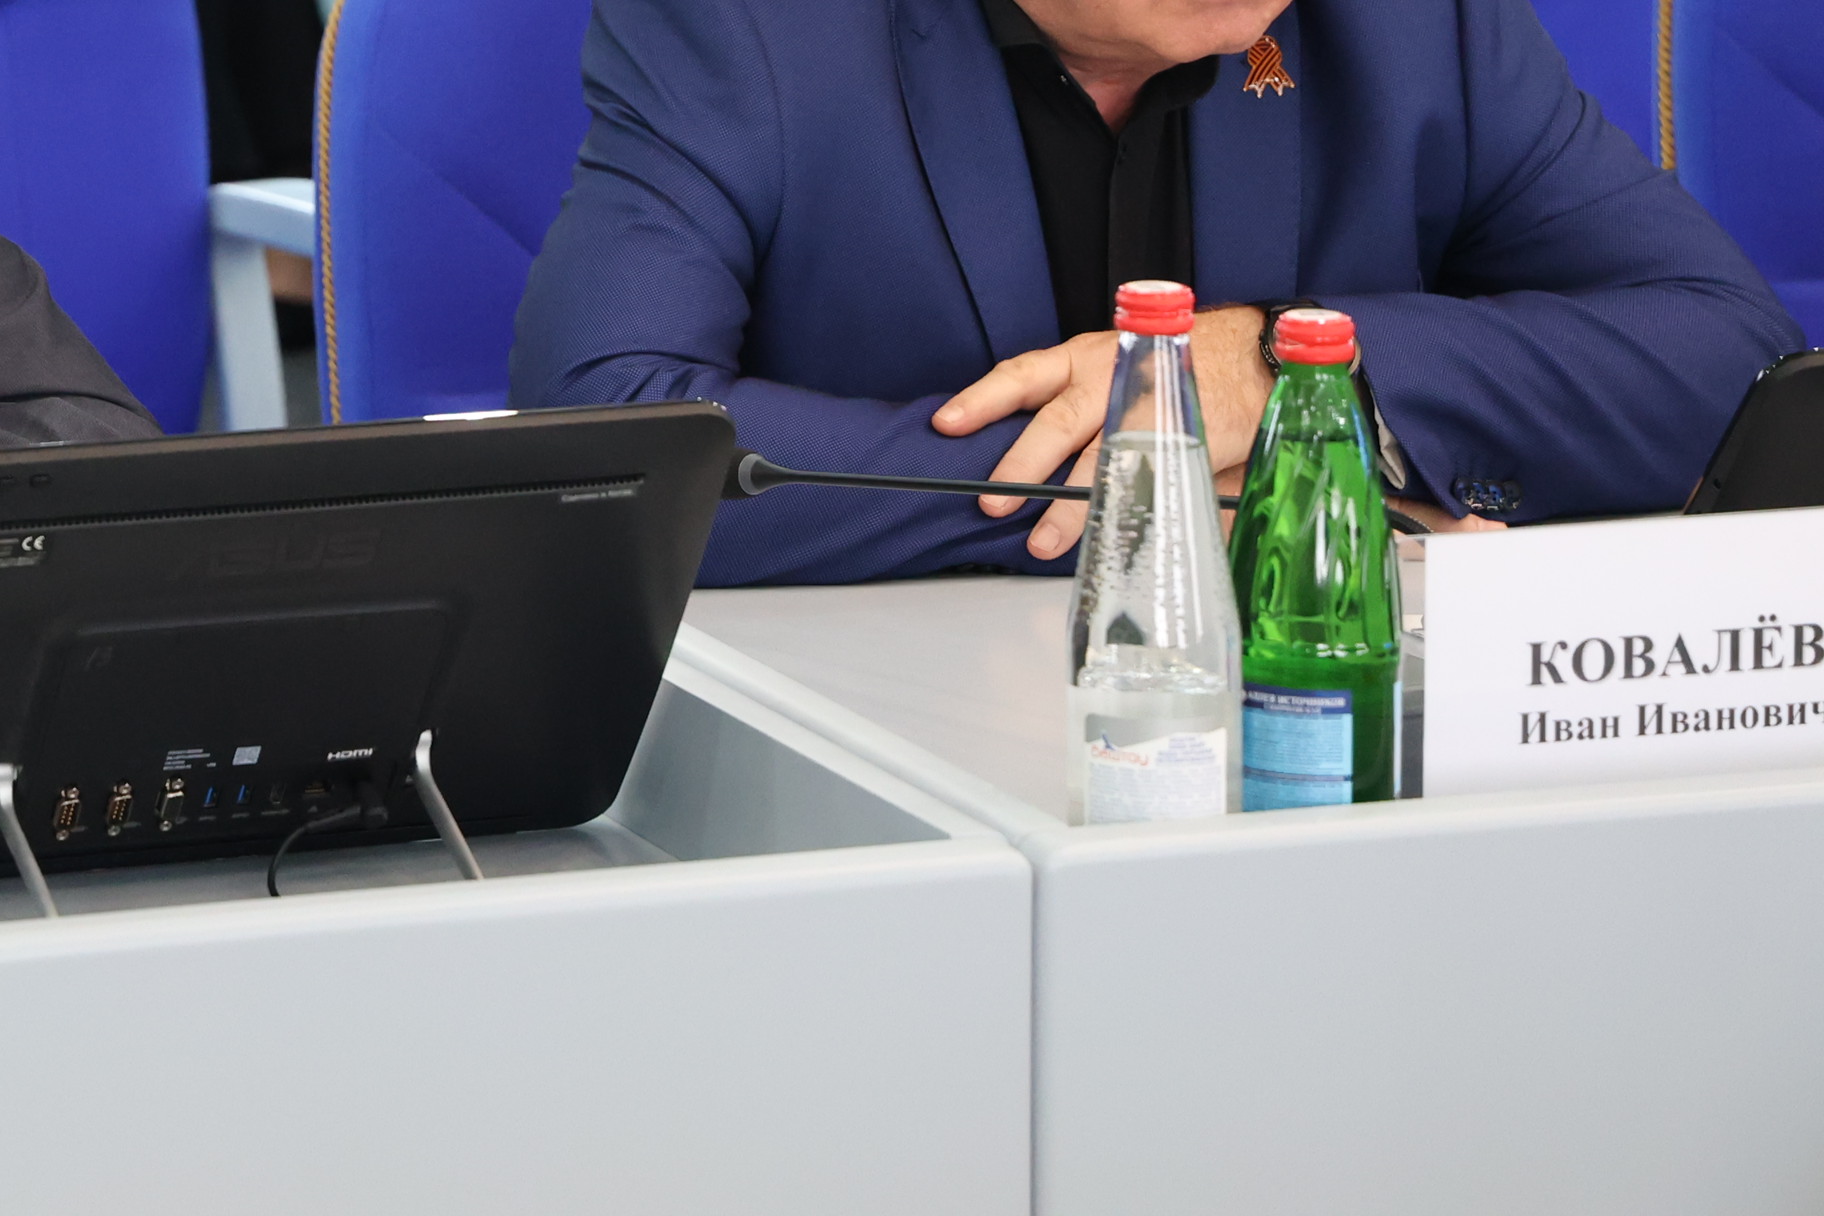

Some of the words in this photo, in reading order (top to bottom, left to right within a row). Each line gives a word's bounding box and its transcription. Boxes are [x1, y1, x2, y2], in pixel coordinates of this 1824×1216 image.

[1526, 614, 1824, 687] КОВАЛЁВ
[1518, 710, 1622, 744] Иван
[327, 748, 374, 761] HDMI
